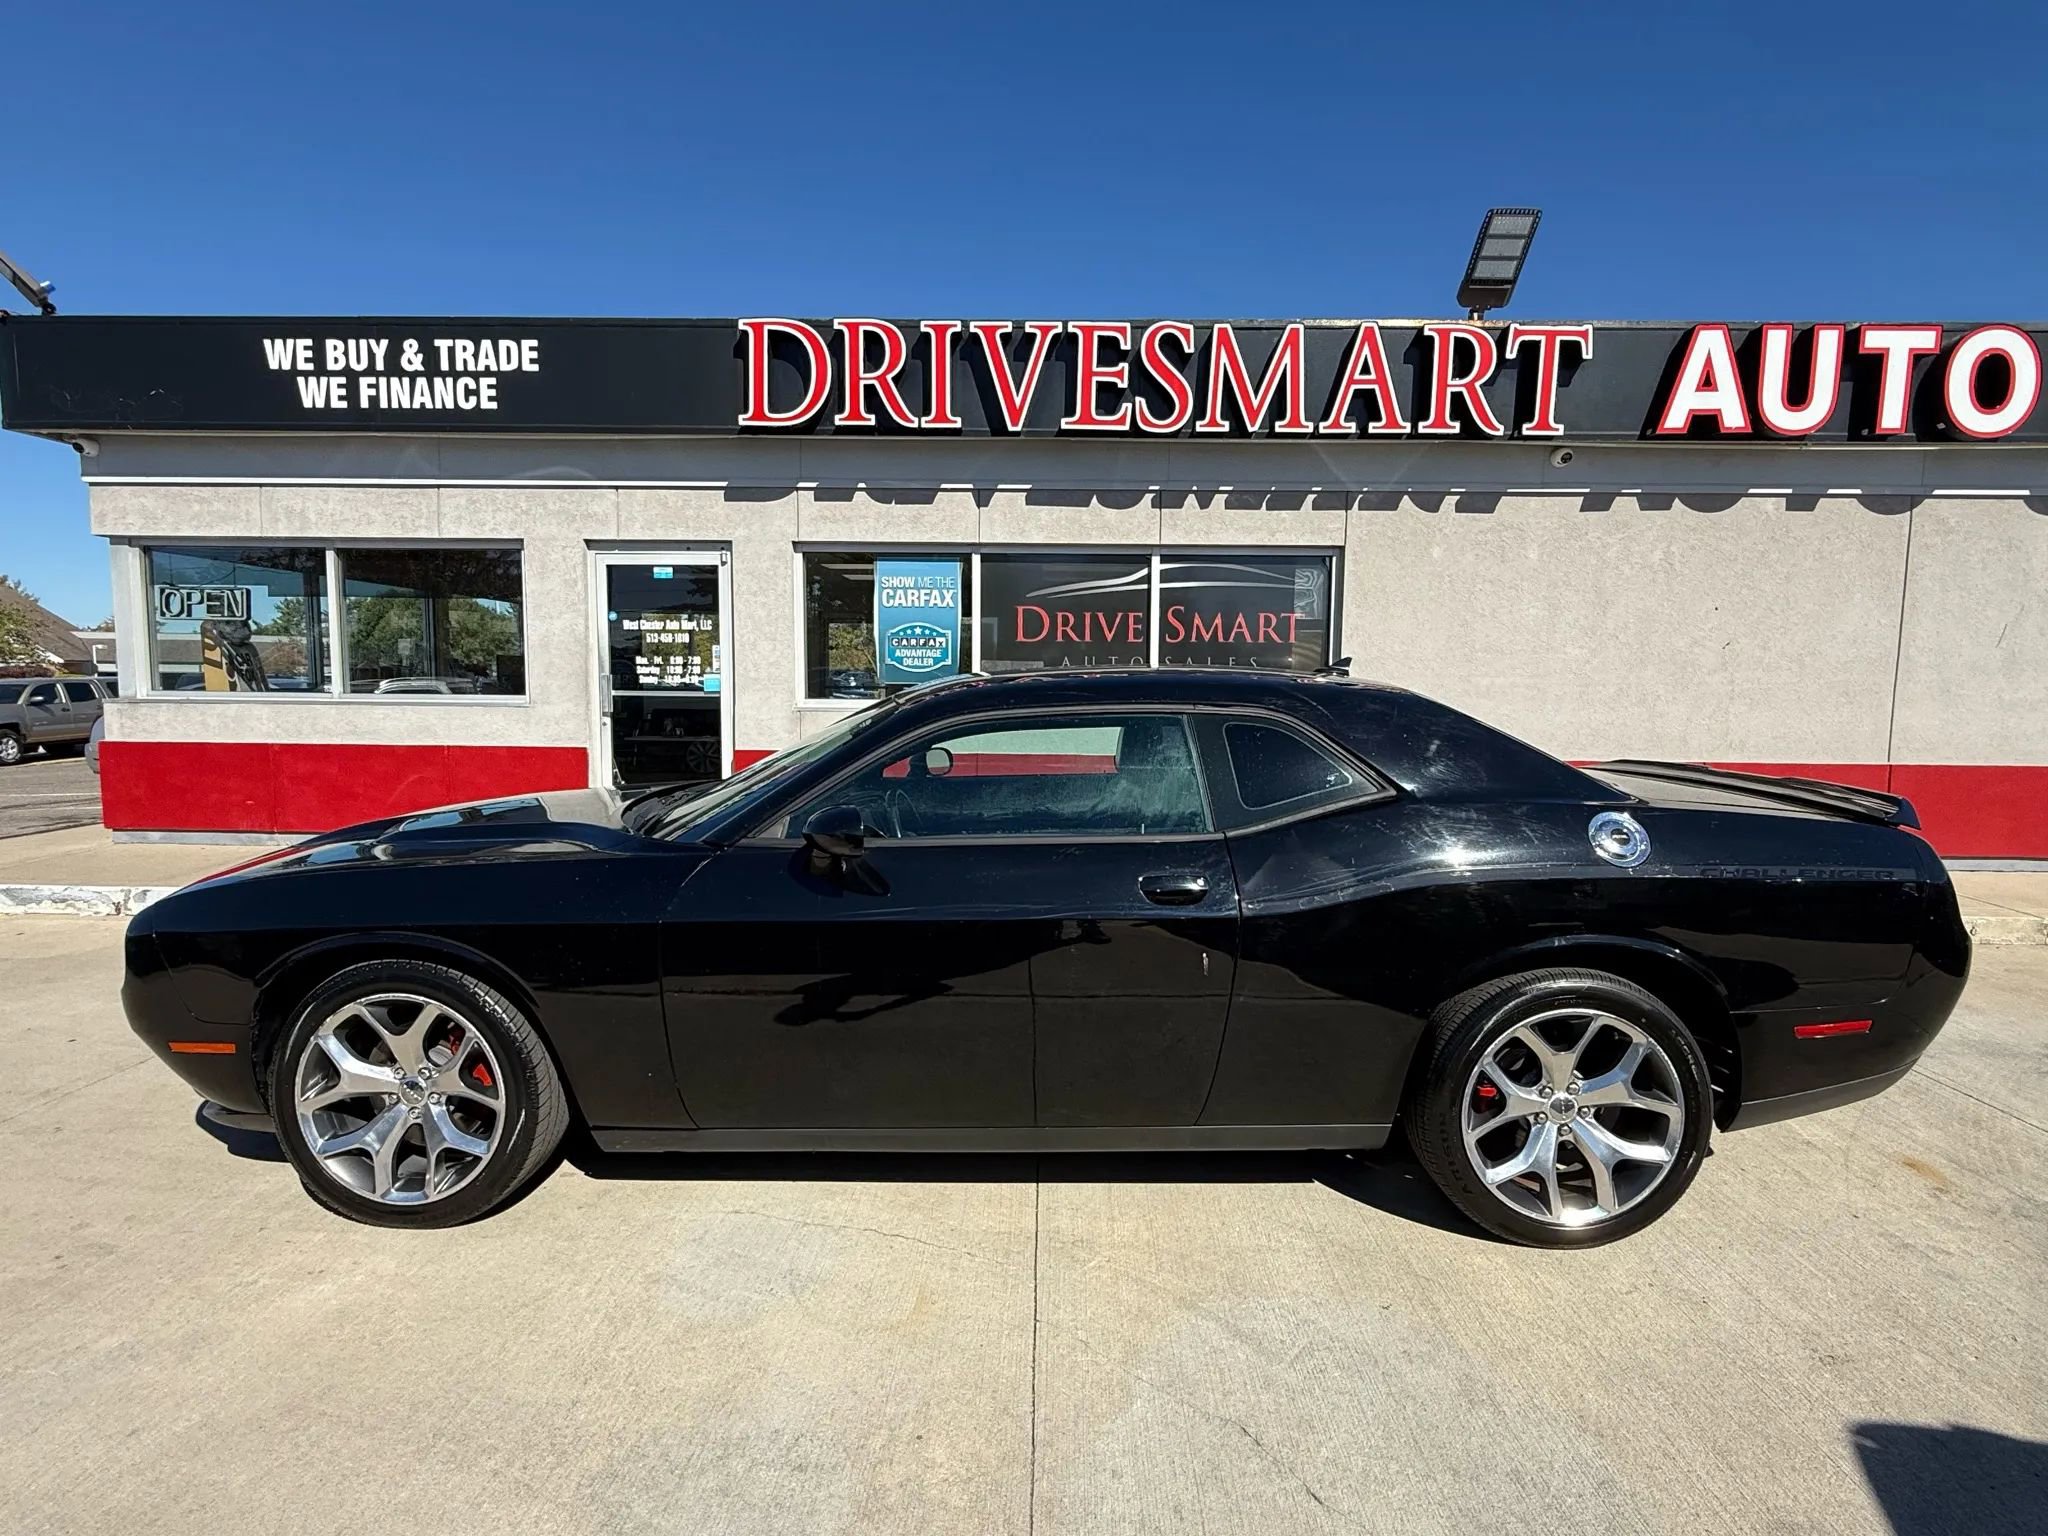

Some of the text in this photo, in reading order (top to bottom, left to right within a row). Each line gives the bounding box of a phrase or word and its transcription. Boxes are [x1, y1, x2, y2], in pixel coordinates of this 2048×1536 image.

[263, 338, 539, 371] WE BUY & TRADE
[737, 317, 2042, 440] DRIVESMART AUTO
[297, 376, 498, 410] WE FINANCE
[881, 576, 955, 588] SHOW ME THE
[162, 589, 242, 617] OPEN
[882, 589, 956, 608] CARFAX
[700, 620, 713, 630] LLC
[1015, 605, 1305, 644] DRIVE SMART
[891, 637, 945, 647] CARFAX
[895, 649, 942, 658] ADVANTAGE
[903, 658, 934, 666] DEALER
[1700, 867, 1895, 880] CHALLENGER
